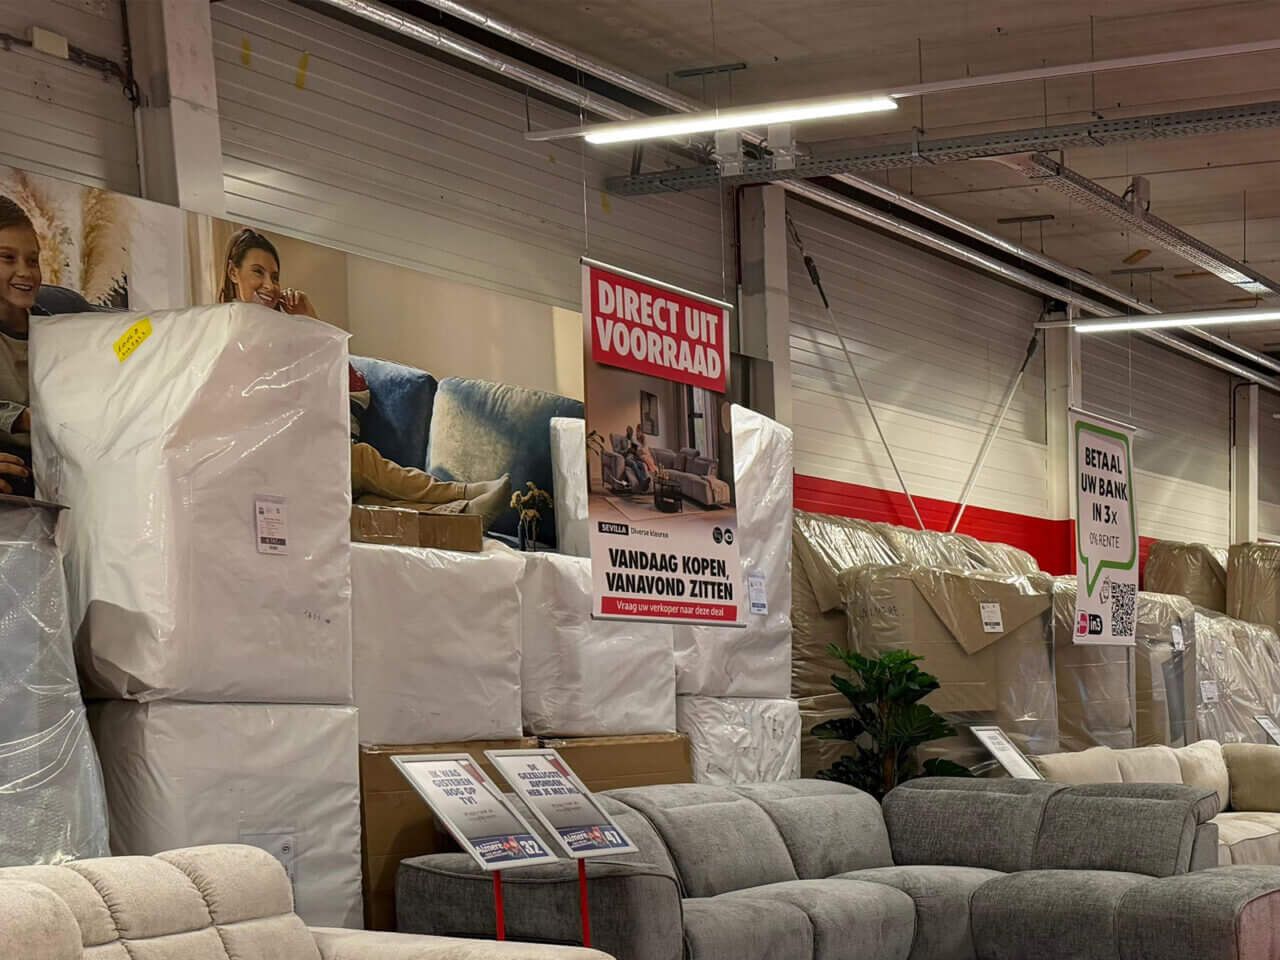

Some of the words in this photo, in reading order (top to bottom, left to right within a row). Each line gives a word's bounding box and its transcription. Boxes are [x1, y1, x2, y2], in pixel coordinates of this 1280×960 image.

[598, 279, 680, 334] DIRECT
[684, 306, 718, 345] UIT
[595, 315, 721, 380] VOORRAAD
[1084, 446, 1123, 475] BETAAL
[1080, 472, 1097, 494] UW
[1098, 478, 1128, 502] BANK
[601, 522, 627, 534] SEVILLA
[1092, 502, 1102, 523] IN
[1104, 504, 1118, 526] 3x
[1098, 534, 1121, 549] RENTE
[608, 547, 679, 573] VANDAAG
[682, 555, 730, 581] KOPEN,
[605, 571, 686, 597] VANAVOND
[689, 579, 733, 601] ZITTEN
[616, 599, 638, 614] Vraag
[638, 602, 649, 612] uw
[650, 602, 679, 616] verkoper
[680, 606, 694, 615] naar
[695, 605, 710, 616] deze
[710, 607, 724, 617] deal
[520, 840, 543, 855] 32
